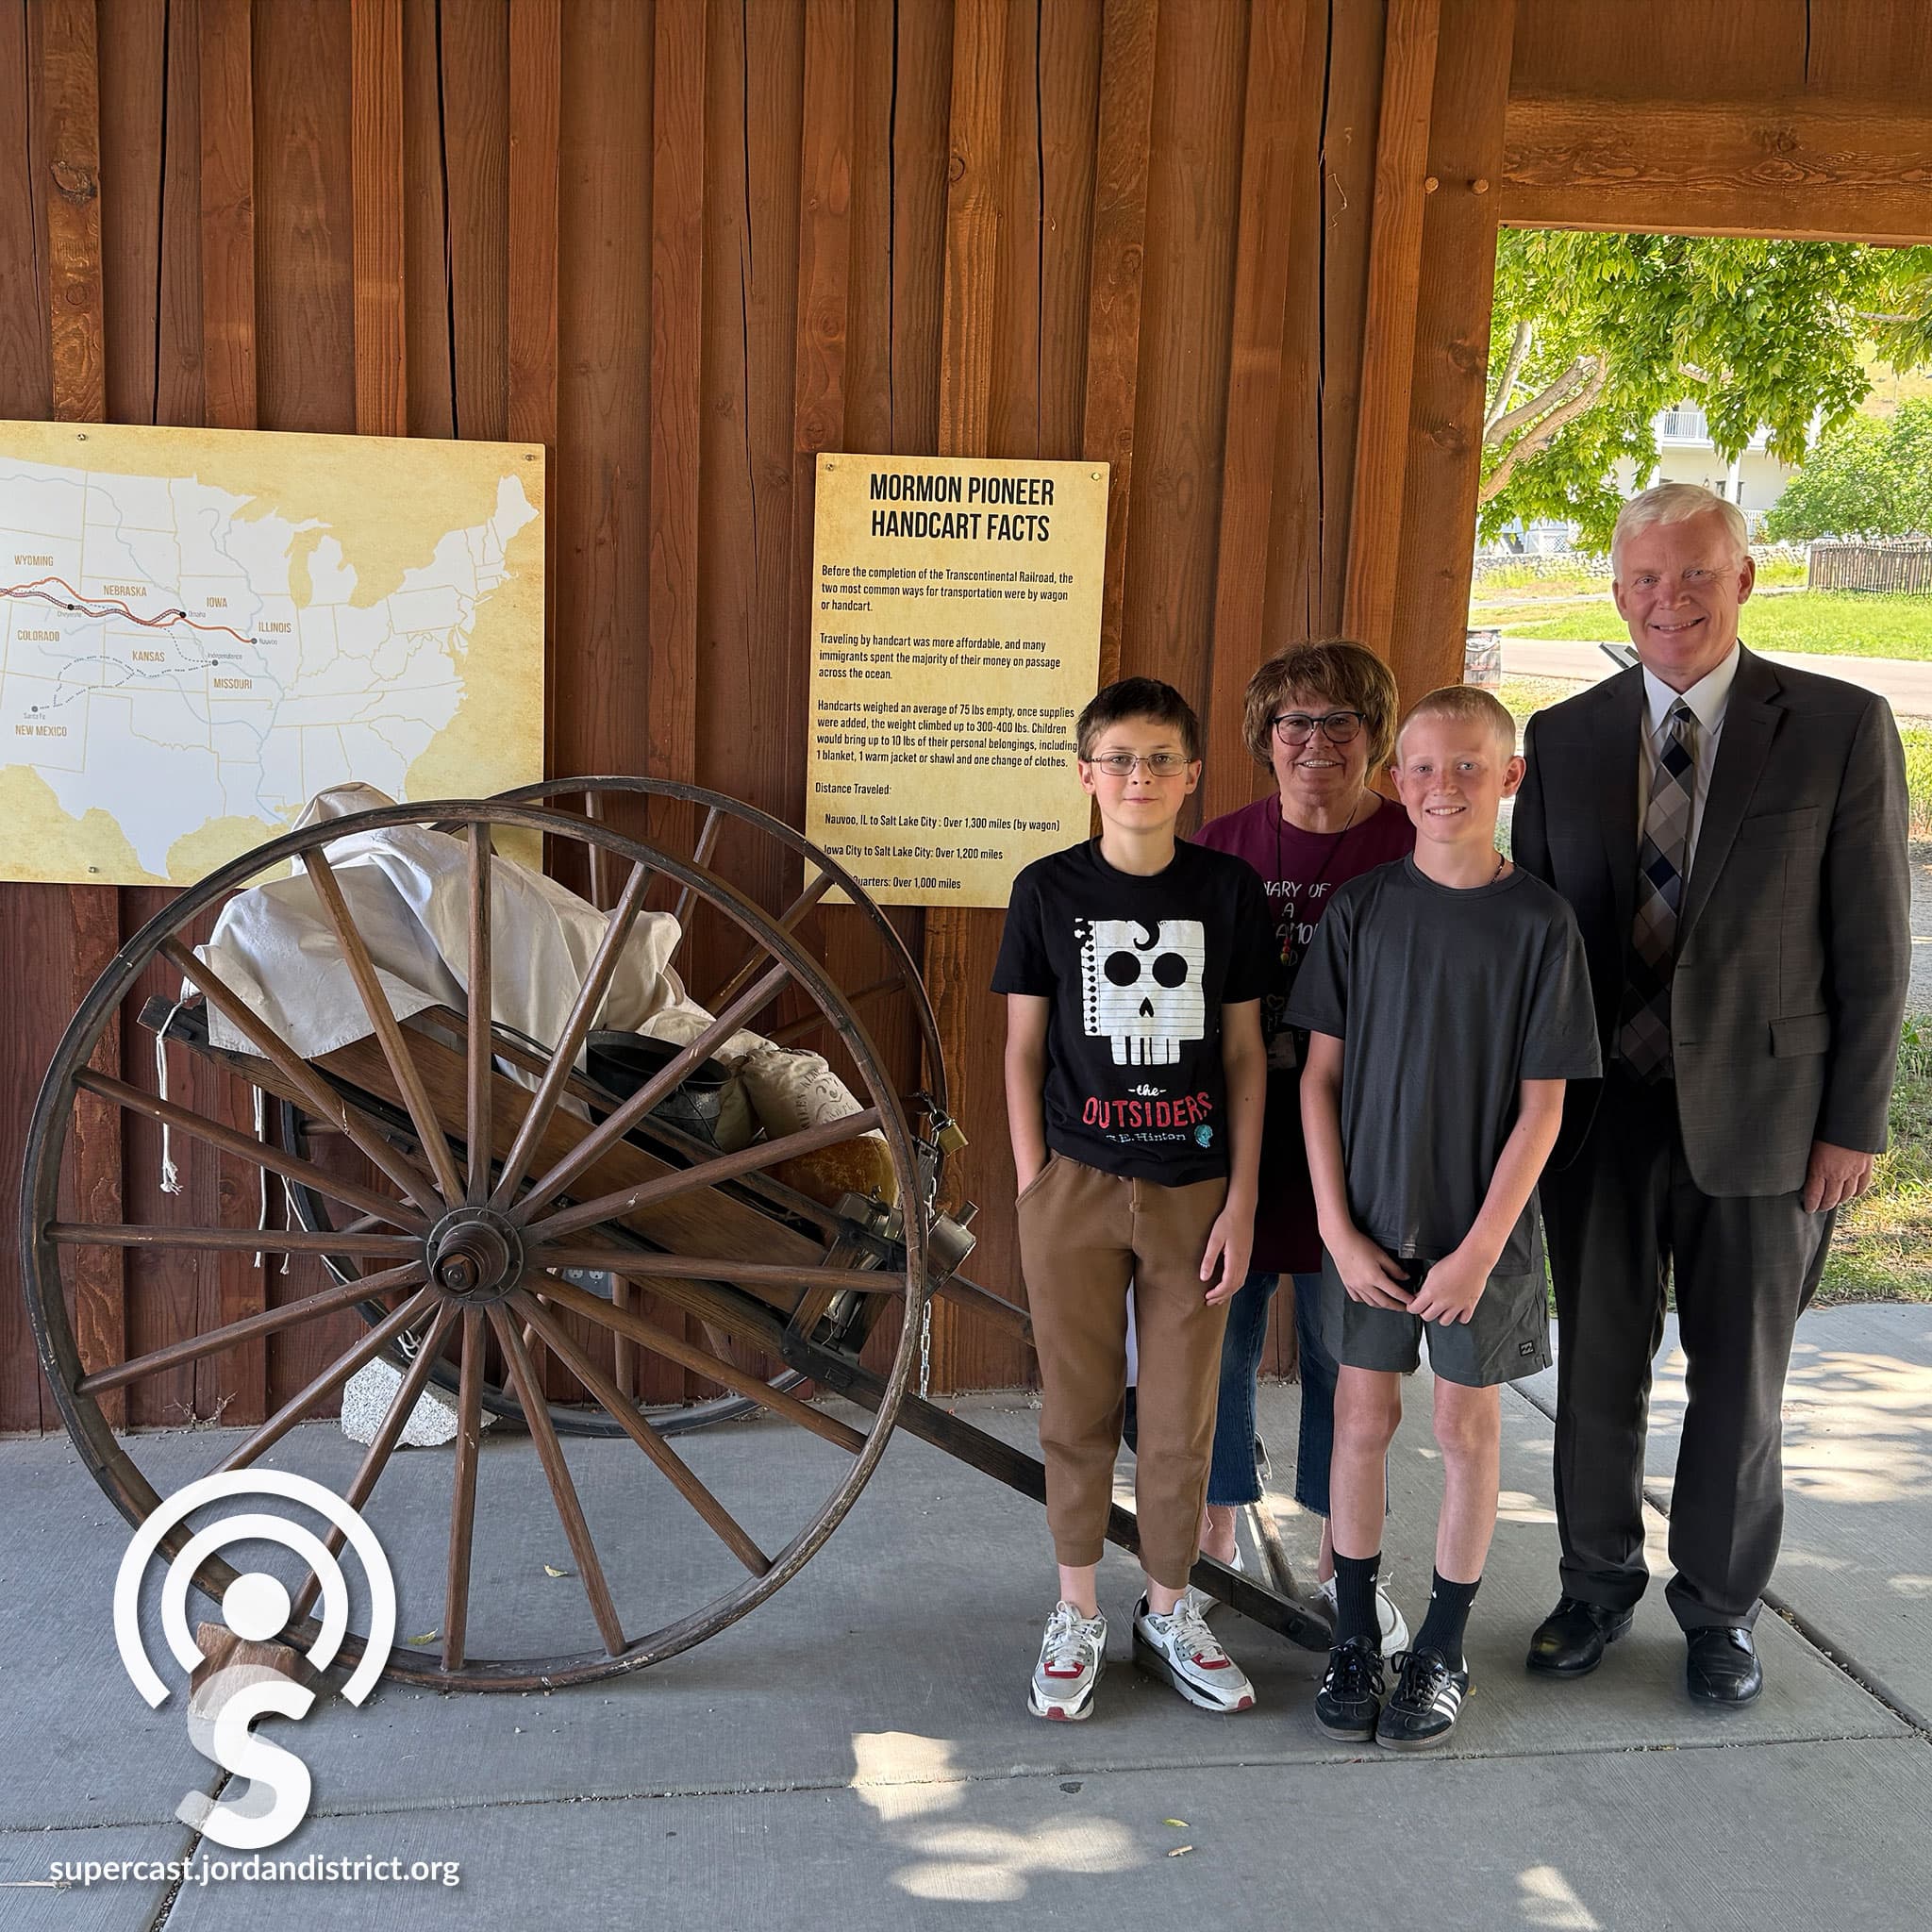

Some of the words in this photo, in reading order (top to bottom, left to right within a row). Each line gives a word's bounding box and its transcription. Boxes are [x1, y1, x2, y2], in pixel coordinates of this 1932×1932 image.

[870, 474, 961, 503] MORMON
[968, 477, 1054, 506] PIONEER
[872, 510, 982, 540] HANDCART
[987, 514, 1050, 541] FACTS
[14, 555, 54, 567] WYOMING
[822, 564, 850, 576] Before
[853, 566, 867, 577] the
[869, 567, 916, 580] completion
[919, 568, 927, 579] of
[929, 569, 943, 579] the
[945, 569, 1018, 582] Transcontinental
[1019, 571, 1057, 584] Railroad,
[1059, 573, 1074, 584] the
[103, 585, 147, 597] NEBRASKA
[822, 582, 838, 593] two
[840, 584, 861, 594] most
[863, 586, 900, 595] common
[902, 587, 924, 598] ways
[925, 585, 939, 596] for
[941, 587, 1002, 599] transportation
[1004, 591, 1025, 599] were
[1027, 589, 1038, 602] by
[1040, 591, 1068, 602] wagon
[206, 596, 227, 608] IOWA
[821, 601, 830, 610] or
[832, 599, 873, 611] handcart.
[258, 621, 291, 633] ILLINOIS
[17, 629, 60, 641] COLORADO
[820, 632, 858, 647] Traveling
[860, 634, 871, 647] by
[873, 634, 911, 646] handcart
[913, 639, 930, 647] was
[932, 639, 955, 648] more
[956, 637, 1003, 649] affordable,
[1005, 639, 1021, 650] and
[1023, 641, 1046, 653] many
[132, 650, 165, 662] KANSAS
[819, 649, 868, 663] immigrants
[870, 653, 894, 664] spent
[896, 652, 910, 663] the
[912, 653, 948, 666] majority
[949, 654, 958, 665] of
[960, 654, 981, 665] their
[983, 658, 1011, 668] money
[1013, 658, 1024, 666] on
[1025, 658, 1060, 670] passage
[819, 669, 847, 678] across
[849, 667, 863, 678] the
[865, 670, 892, 679] ocean.
[213, 677, 253, 690] MISSOURI
[818, 699, 861, 711] Handcarts
[863, 701, 899, 714] weighed
[901, 705, 911, 713] an
[913, 706, 947, 716] average
[949, 704, 958, 714] of
[959, 704, 970, 715] 75
[972, 704, 985, 715] lbs
[986, 706, 1015, 718] empty,
[1017, 708, 1038, 717] once
[1040, 707, 1074, 720] supplies
[15, 724, 33, 736] NEW
[35, 725, 67, 737] MEXICO
[817, 719, 839, 727] were
[841, 717, 869, 729] added,
[872, 718, 885, 729] the
[887, 719, 916, 732] weight
[918, 720, 952, 731] climbed
[954, 723, 964, 733] up
[966, 722, 975, 731] to
[976, 721, 1013, 733] 300-400
[1015, 722, 1029, 733] lbs.
[1032, 723, 1067, 734] Children
[817, 733, 842, 744] would
[844, 733, 866, 747] bring
[868, 737, 879, 747] up
[881, 736, 890, 745] to
[891, 735, 901, 746] 10
[903, 735, 915, 746] lbs
[917, 736, 926, 747] of
[928, 736, 949, 747] their
[950, 738, 987, 749] personal
[989, 738, 1037, 752] belongings,
[1040, 740, 1077, 754] including
[817, 749, 821, 759] 1
[823, 749, 857, 762] blanket,
[858, 751, 862, 761] 1
[865, 753, 889, 762] warm
[891, 752, 917, 764] jacket
[919, 755, 928, 763] or
[930, 753, 955, 764] shawl
[957, 754, 972, 764] and
[974, 757, 990, 765] one
[991, 755, 1023, 768] change
[1024, 755, 1033, 766] of
[1034, 756, 1068, 767] clothes.
[815, 782, 852, 793] Distance
[854, 783, 891, 795] Traveled:
[825, 813, 858, 825] Nauvoo,
[860, 814, 868, 825] IL
[870, 816, 878, 825] to
[880, 815, 897, 826] Salt
[898, 815, 919, 826] Lake
[921, 816, 937, 829] City
[943, 817, 963, 827] Over
[965, 817, 987, 829] 1,300
[989, 818, 1011, 829] miles
[1013, 819, 1027, 832] (by
[1029, 820, 1059, 832] wagon)
[823, 844, 843, 855] Iowa
[845, 844, 862, 858] City
[864, 846, 873, 857] to
[874, 845, 891, 857] Salt
[892, 845, 913, 857] Lake
[914, 846, 934, 859] City:
[935, 847, 955, 858] Over
[957, 848, 978, 859] 1,200
[980, 849, 1003, 859] miles
[893, 876, 912, 888] Over
[914, 877, 937, 889] 1,000
[939, 877, 961, 889] miles
[1308, 883, 1331, 897] OF
[1281, 902, 1295, 918] A
[1082, 1091, 1212, 1129] OUTSIDERS
